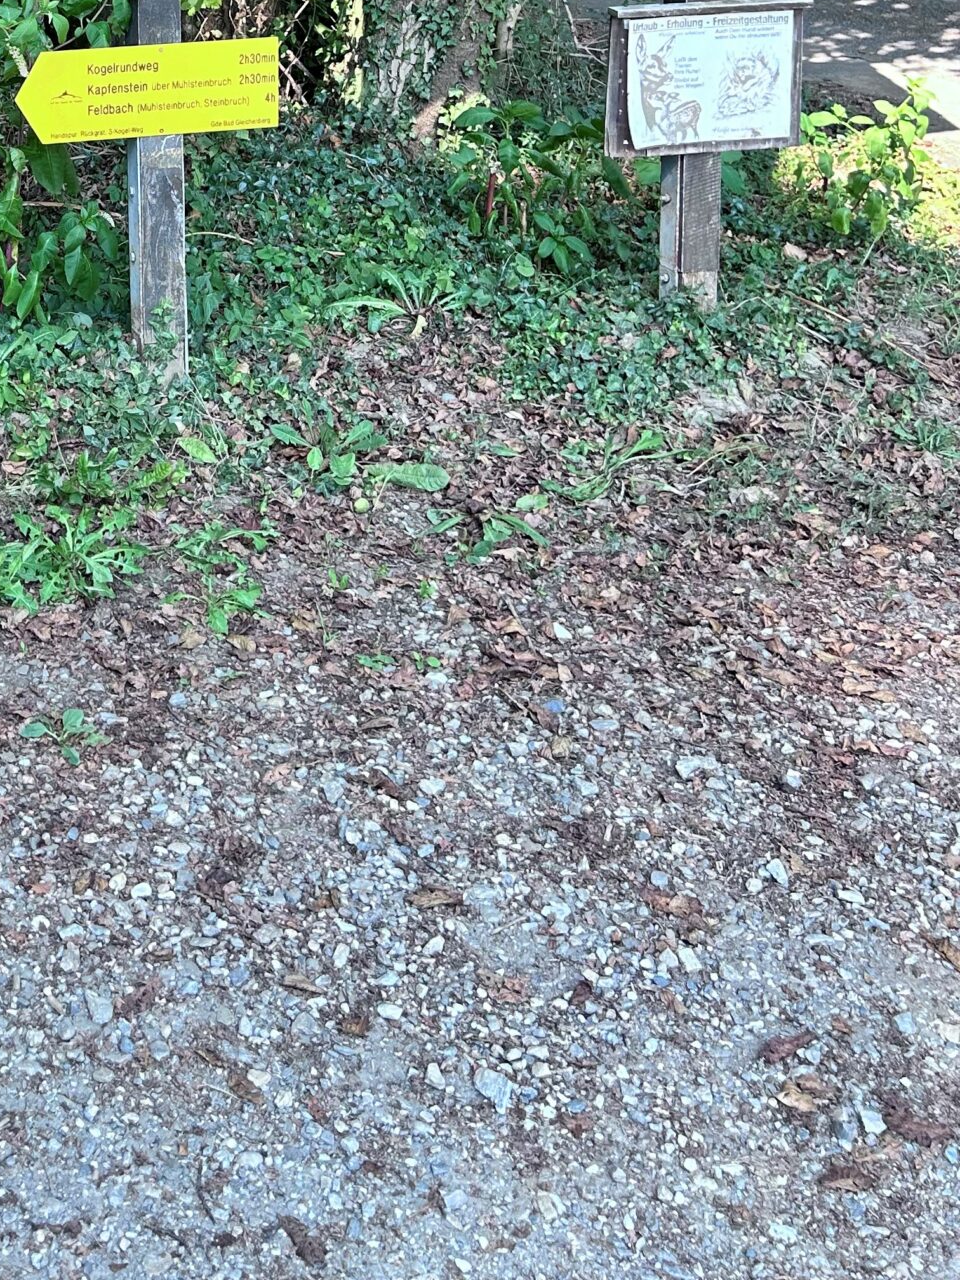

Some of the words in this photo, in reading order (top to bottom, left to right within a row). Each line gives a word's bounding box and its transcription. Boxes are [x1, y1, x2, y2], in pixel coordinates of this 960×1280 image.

[632, 21, 658, 32] Urlaub
[666, 18, 703, 29] Erholung
[712, 14, 789, 27] Freizeitgestaltung
[239, 53, 276, 65] 2h30min
[87, 61, 159, 77] Kogelrundweg
[239, 73, 276, 85] 2h30min
[87, 81, 149, 97] Kapfenstein
[264, 92, 276, 103] 4h
[87, 101, 134, 116] Feldbach
[203, 96, 250, 108] Steinbruch)
